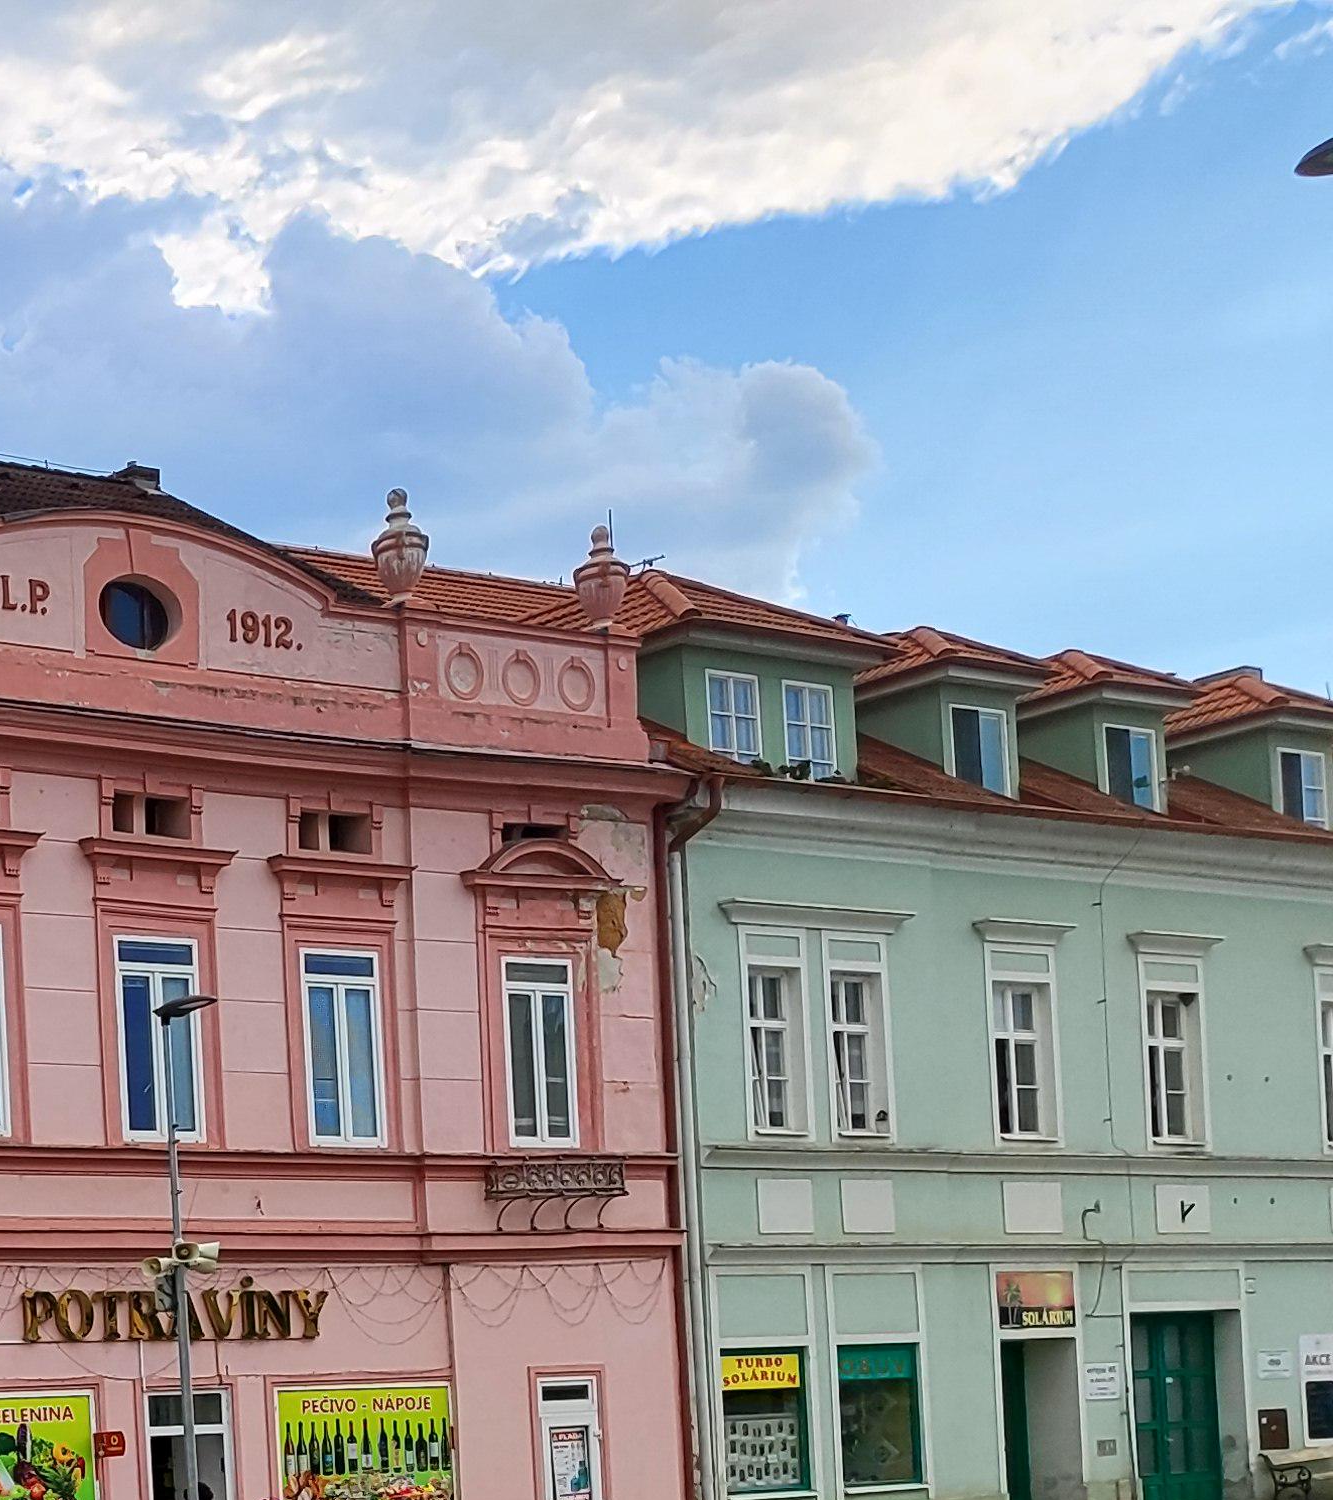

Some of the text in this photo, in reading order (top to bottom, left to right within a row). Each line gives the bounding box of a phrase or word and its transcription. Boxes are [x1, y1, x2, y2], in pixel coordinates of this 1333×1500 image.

[0, 575, 50, 615] L.P.
[226, 609, 303, 651] 1912.
[1022, 1307, 1074, 1327] SOLÁRIUM
[735, 1357, 783, 1369] TURBO
[723, 1370, 797, 1387] SOLÁRIUM
[302, 1394, 431, 1413] PEČIVO NÁPOJE
